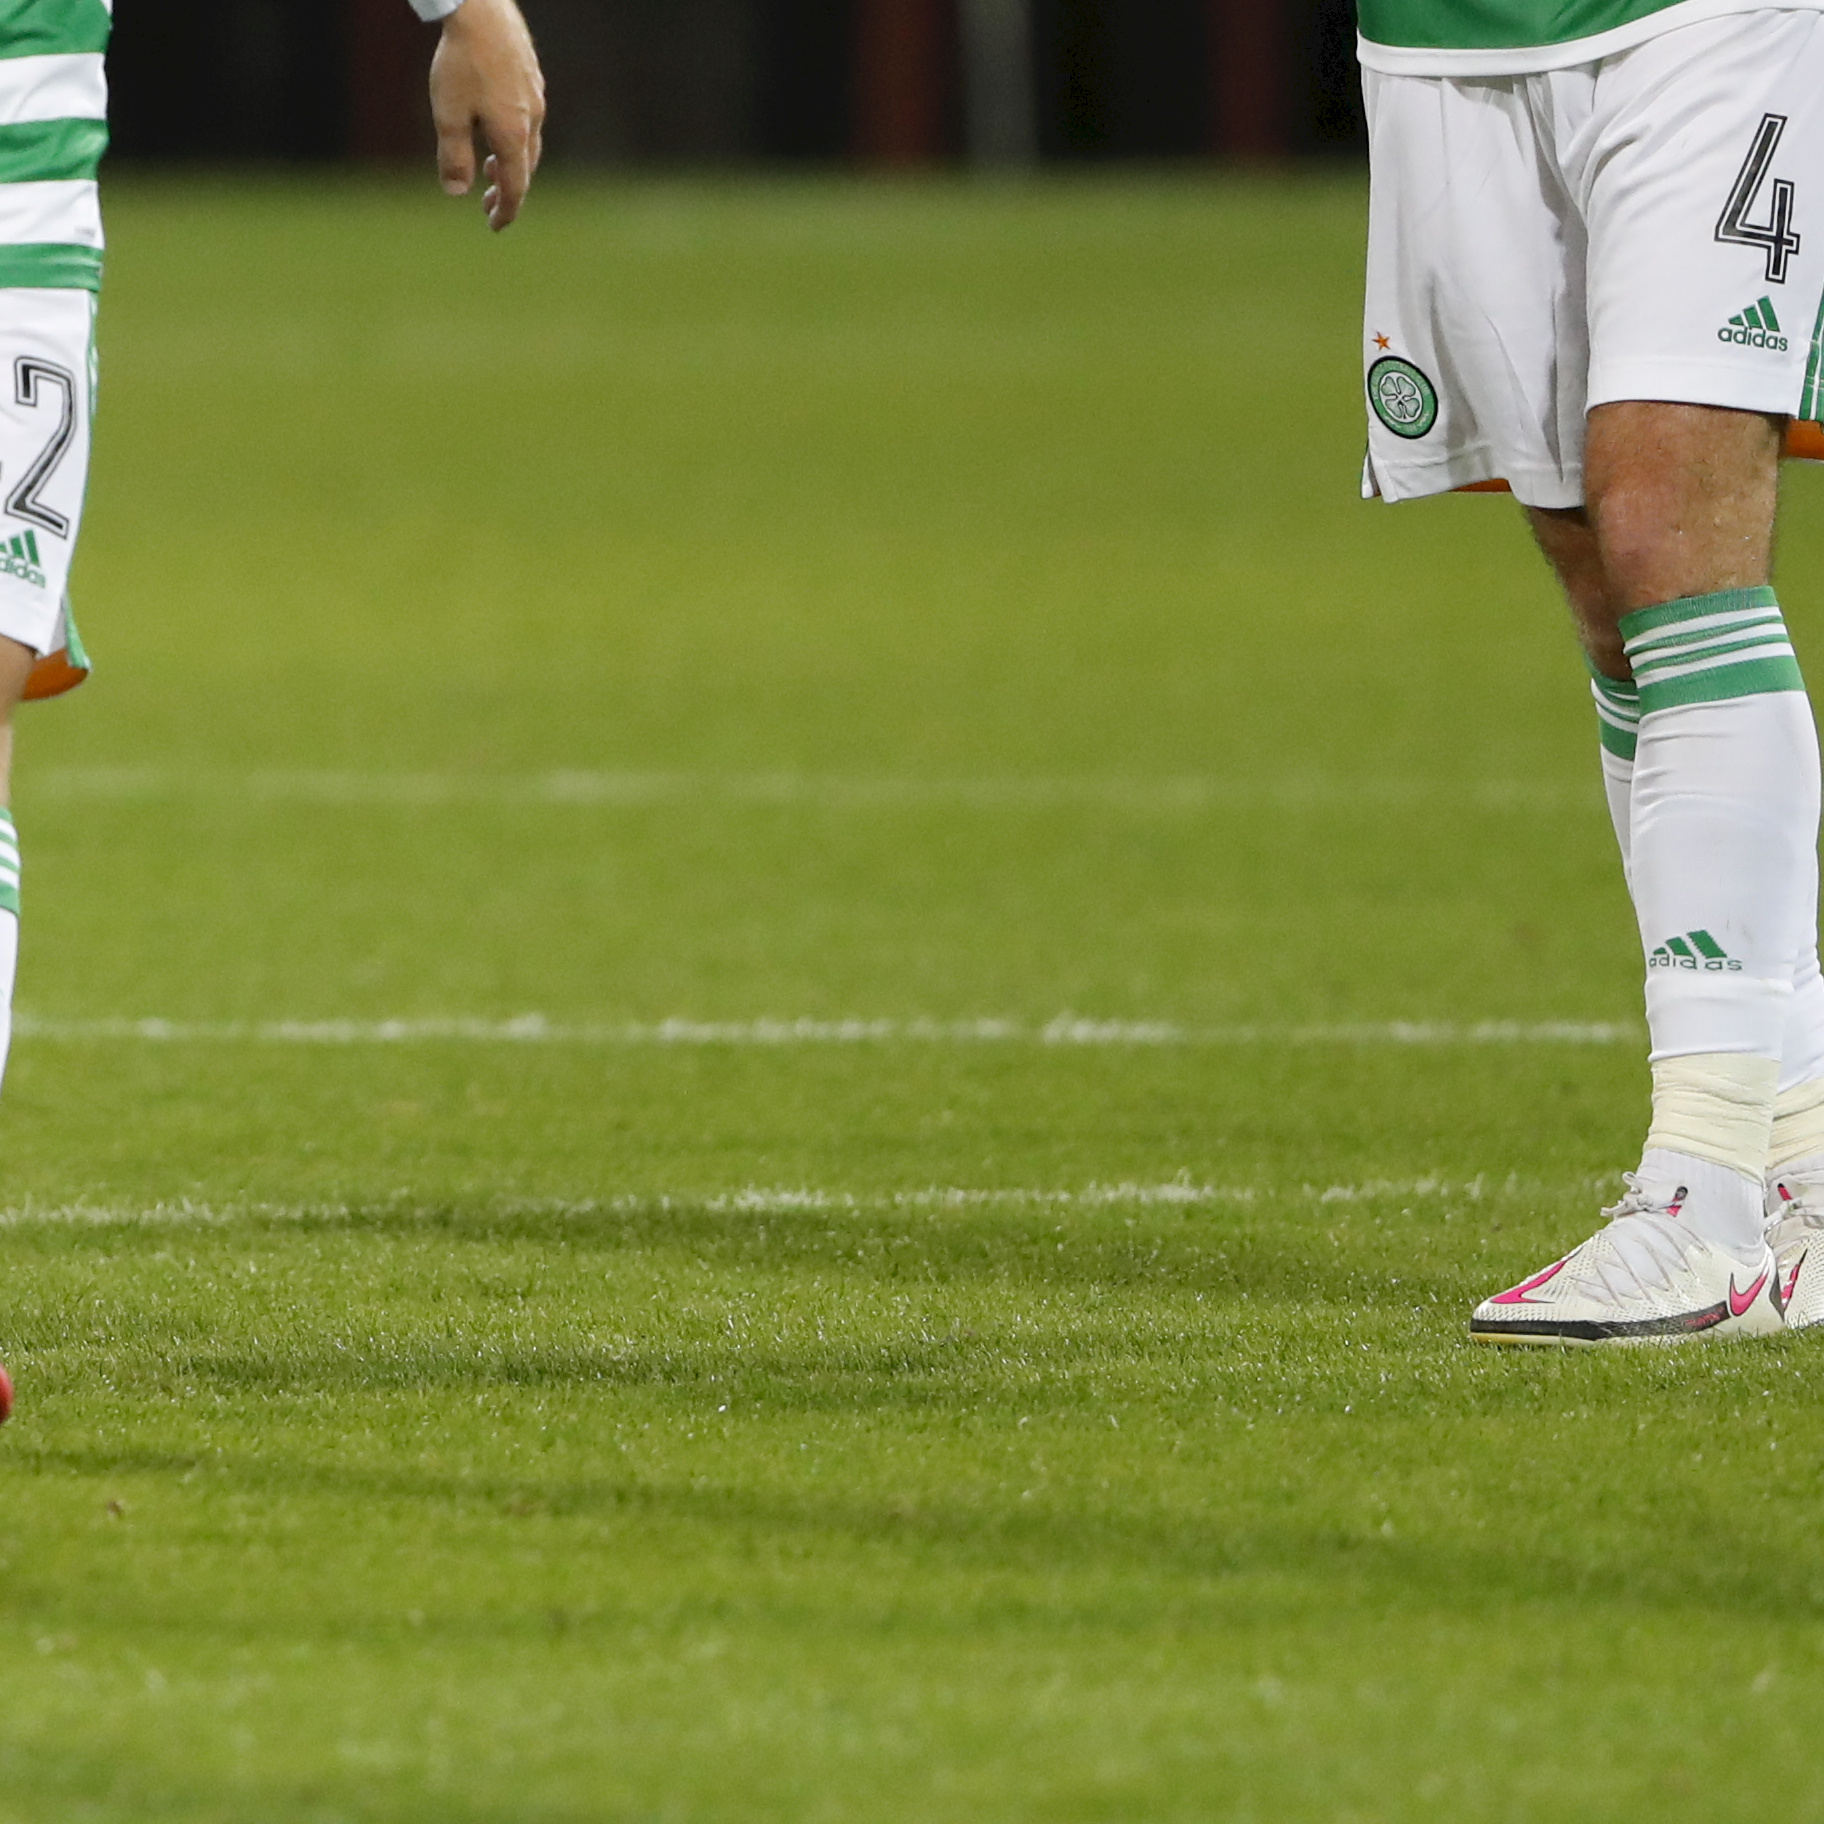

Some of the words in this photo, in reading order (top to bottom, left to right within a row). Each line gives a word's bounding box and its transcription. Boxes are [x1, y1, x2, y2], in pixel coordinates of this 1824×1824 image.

[1714, 112, 1801, 285] 4
[1717, 325, 1789, 352] adidas
[1649, 954, 1743, 971] adidas
